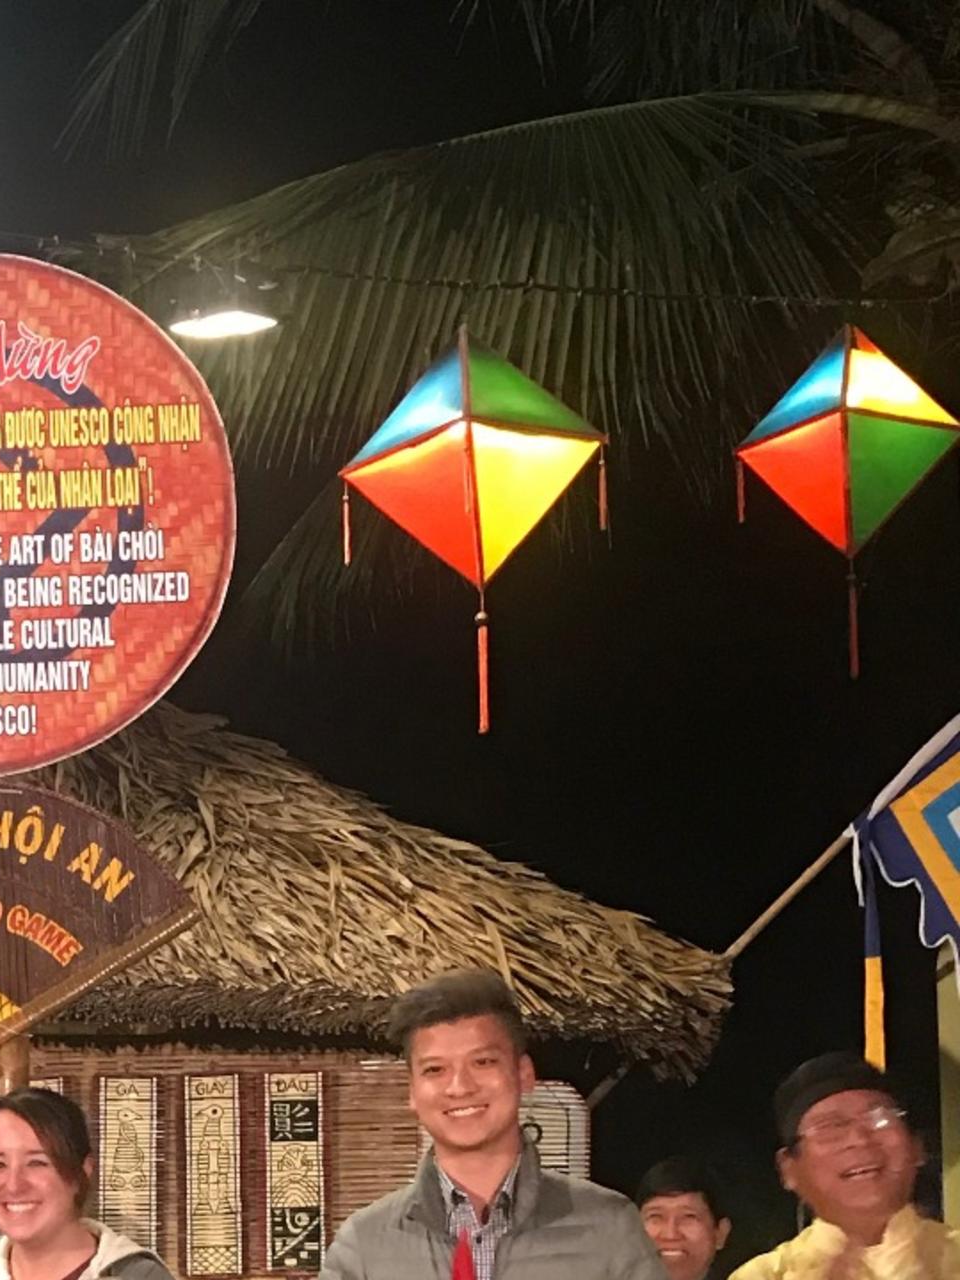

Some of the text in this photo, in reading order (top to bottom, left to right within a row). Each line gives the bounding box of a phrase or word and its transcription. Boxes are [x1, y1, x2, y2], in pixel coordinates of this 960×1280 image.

[5, 406, 45, 457] ĐƯỢC
[49, 406, 109, 448] UNESCO
[113, 398, 155, 445] CÔNG
[159, 396, 201, 450] NHẬN
[26, 458, 58, 510] CỦA
[60, 462, 103, 510] NHÂN
[9, 534, 46, 566] ART
[50, 533, 74, 564] OF
[79, 526, 113, 563] BÀI
[118, 522, 164, 561] CHÒI
[3, 576, 63, 608] BEING
[68, 571, 190, 605] RECOGNIZED
[21, 616, 115, 649] CULTURAL
[66, 842, 135, 903] AN
[6, 904, 84, 968] GAME
